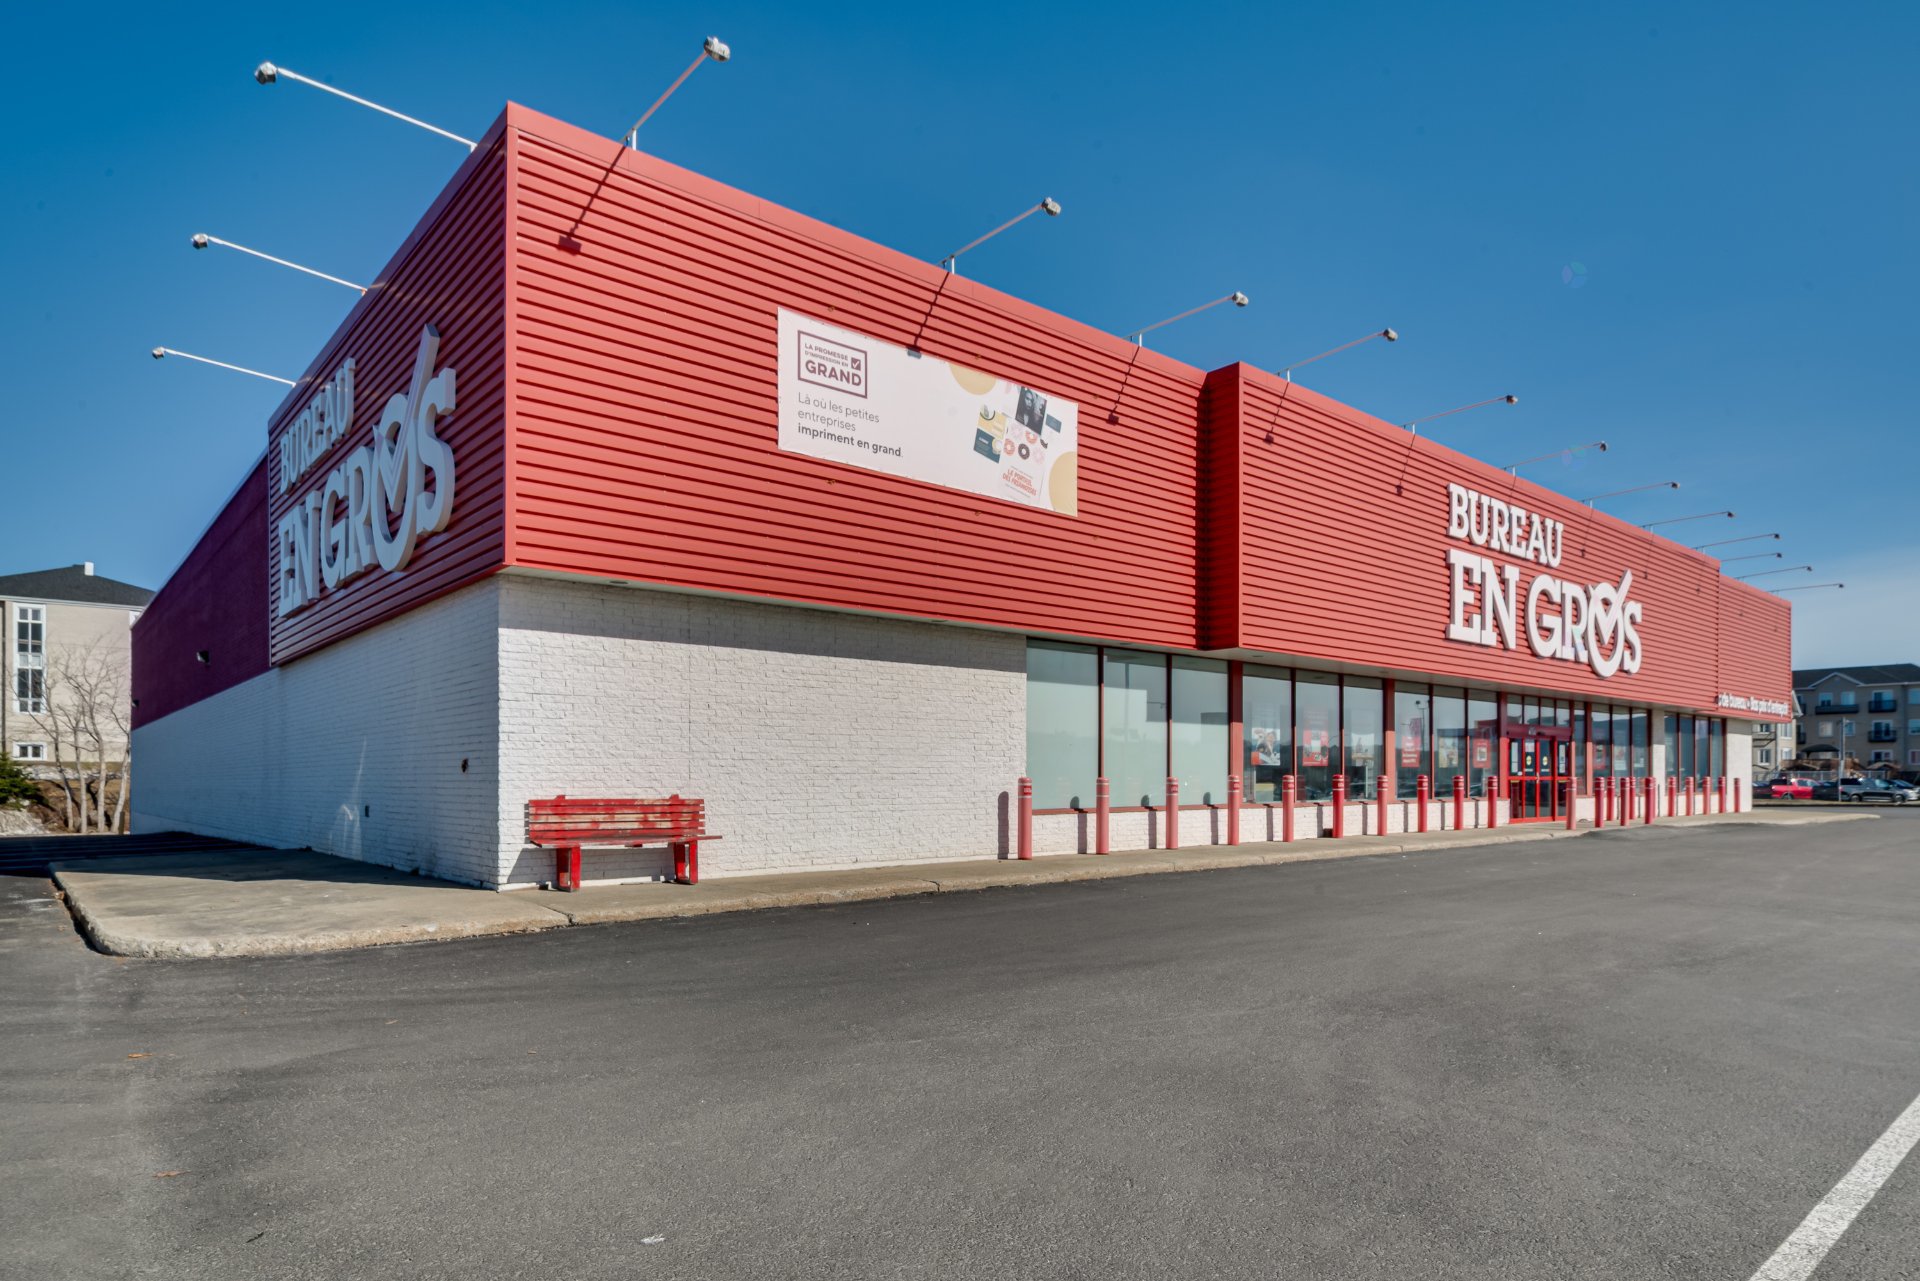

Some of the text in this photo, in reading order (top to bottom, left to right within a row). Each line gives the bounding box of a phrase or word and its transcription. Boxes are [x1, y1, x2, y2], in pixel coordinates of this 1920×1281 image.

[804, 350, 840, 365] D'IMPRESSION
[814, 346, 848, 361] PROMESSE
[805, 359, 862, 386] GRAND
[798, 392, 880, 423] Là où les petites
[798, 410, 856, 432] entreprises
[279, 357, 356, 495] BUREAU
[798, 422, 855, 446] impriment
[857, 440, 870, 449] en
[278, 323, 456, 618] EN GROS
[1446, 483, 1565, 568] BUREAU
[1445, 548, 1643, 678] EN GROS
